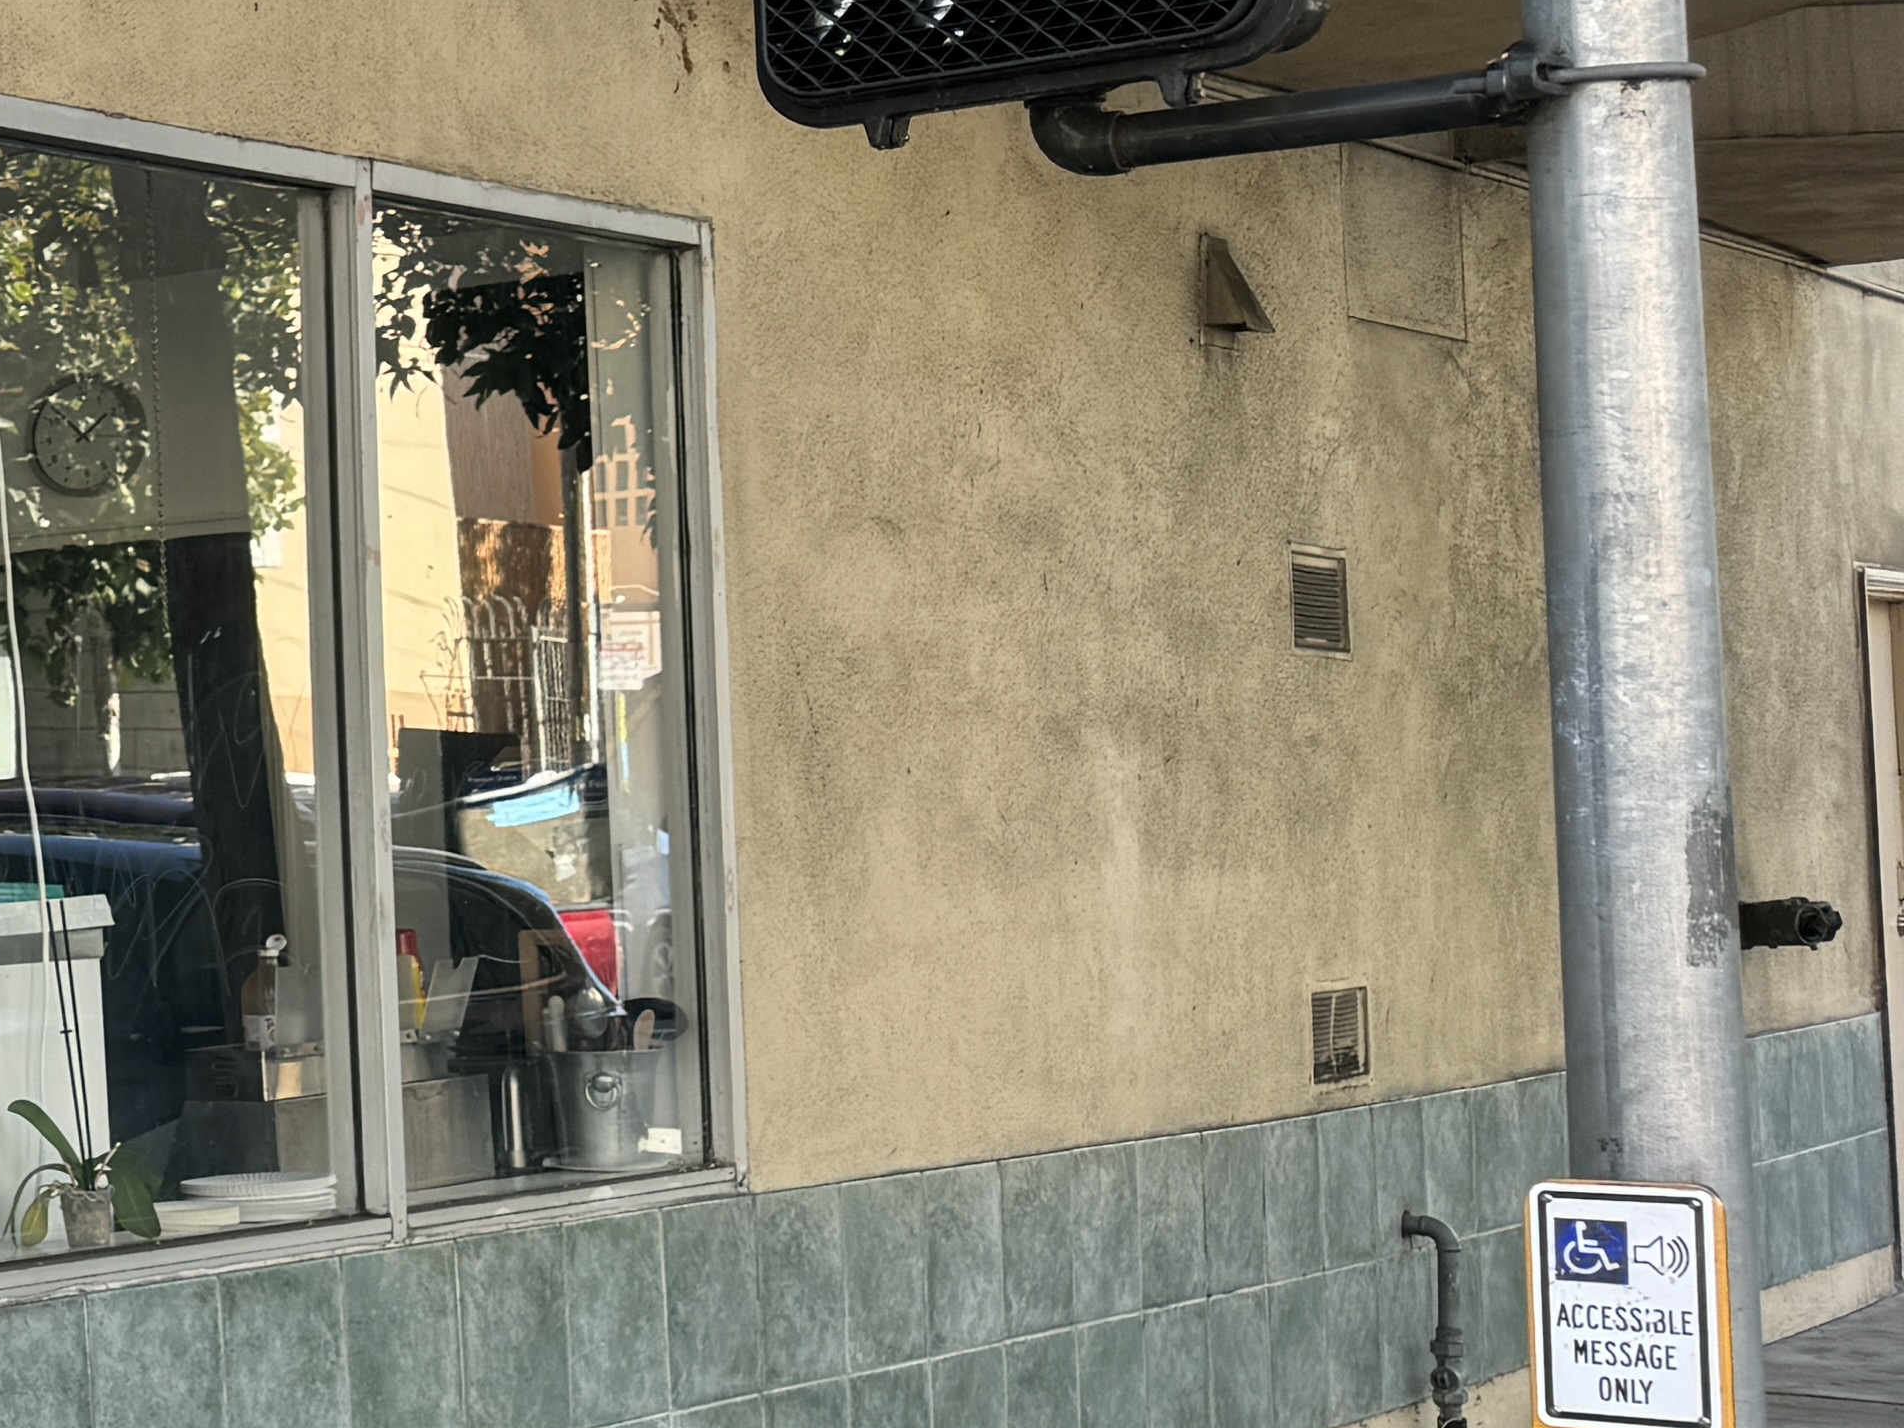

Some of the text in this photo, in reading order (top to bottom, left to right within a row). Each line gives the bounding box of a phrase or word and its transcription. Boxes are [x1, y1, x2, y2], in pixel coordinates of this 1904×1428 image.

[1557, 1303, 1694, 1336] ACCESSIBLE
[1574, 1339, 1677, 1370] MESSAGE
[1599, 1376, 1653, 1404] ONLY
